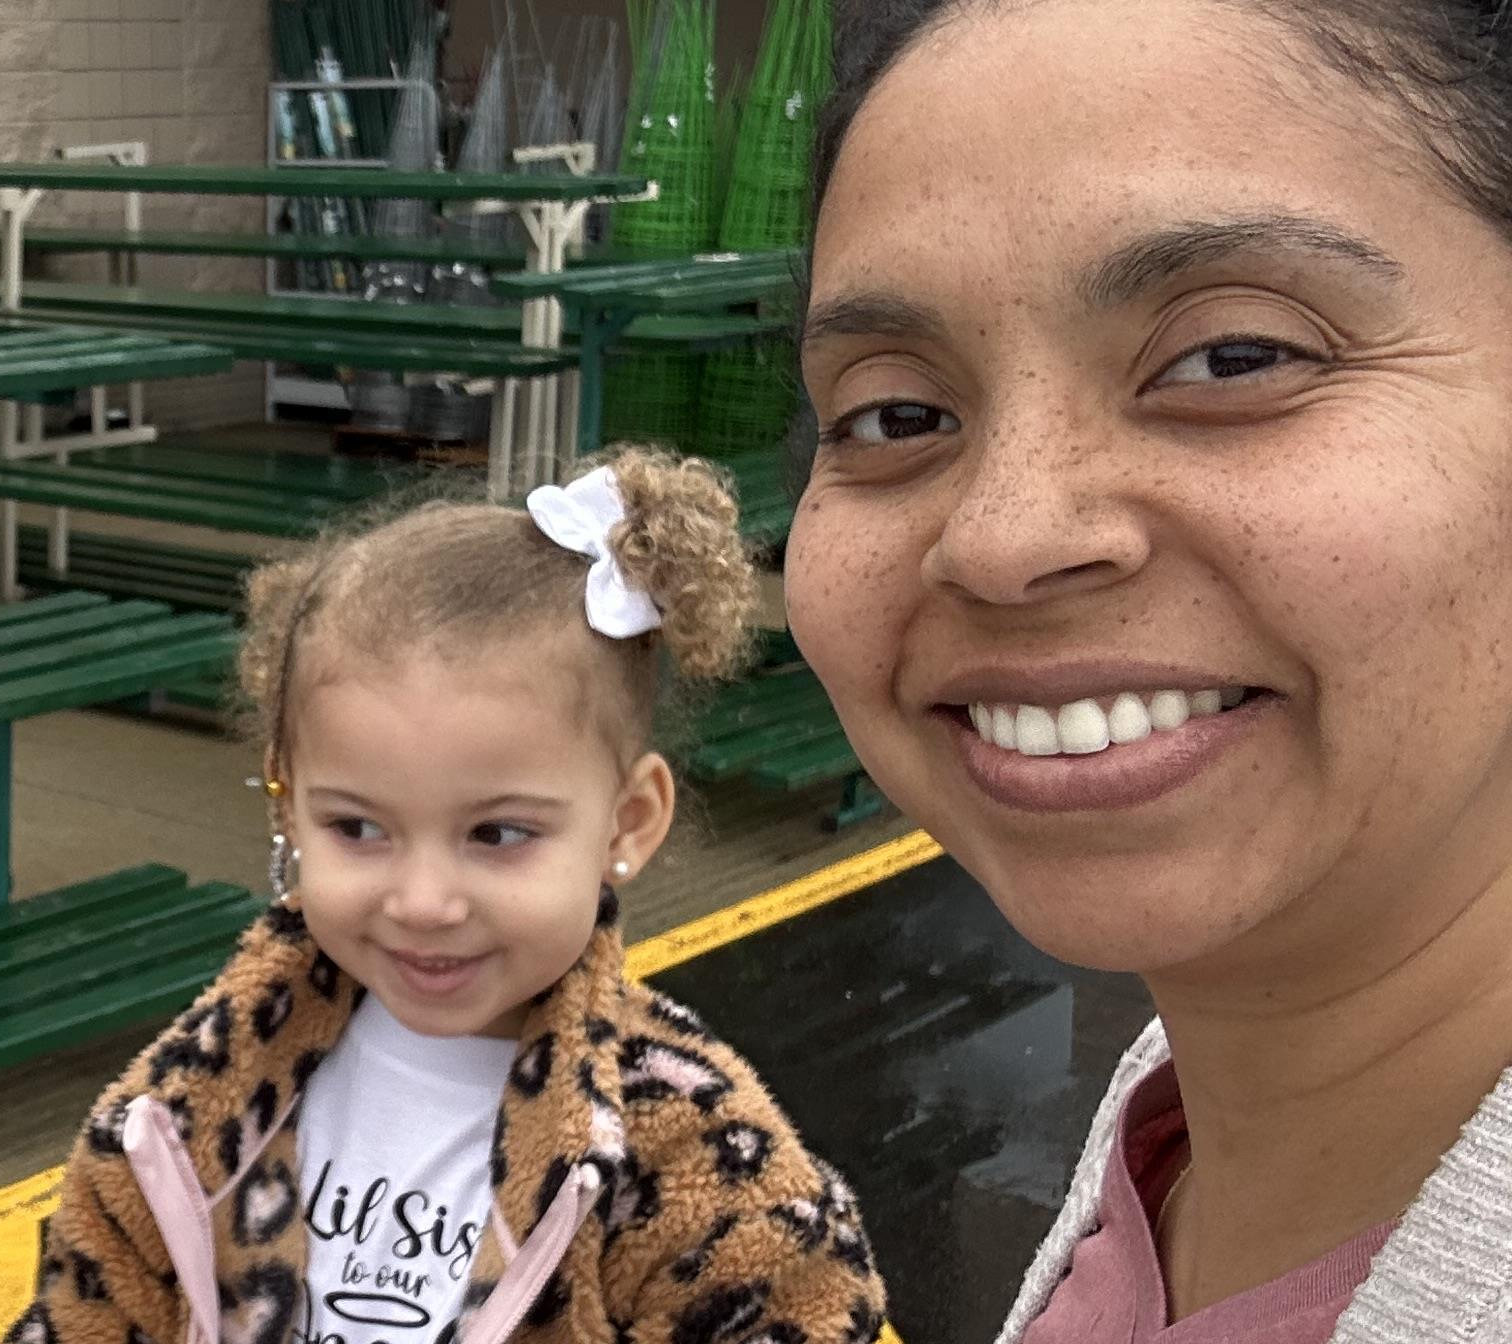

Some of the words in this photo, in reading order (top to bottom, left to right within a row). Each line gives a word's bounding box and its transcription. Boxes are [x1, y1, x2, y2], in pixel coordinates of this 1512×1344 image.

[304, 1159, 388, 1244] Lil
[392, 1189, 486, 1281] Sis
[341, 1251, 371, 1285] to
[375, 1263, 431, 1297] our
